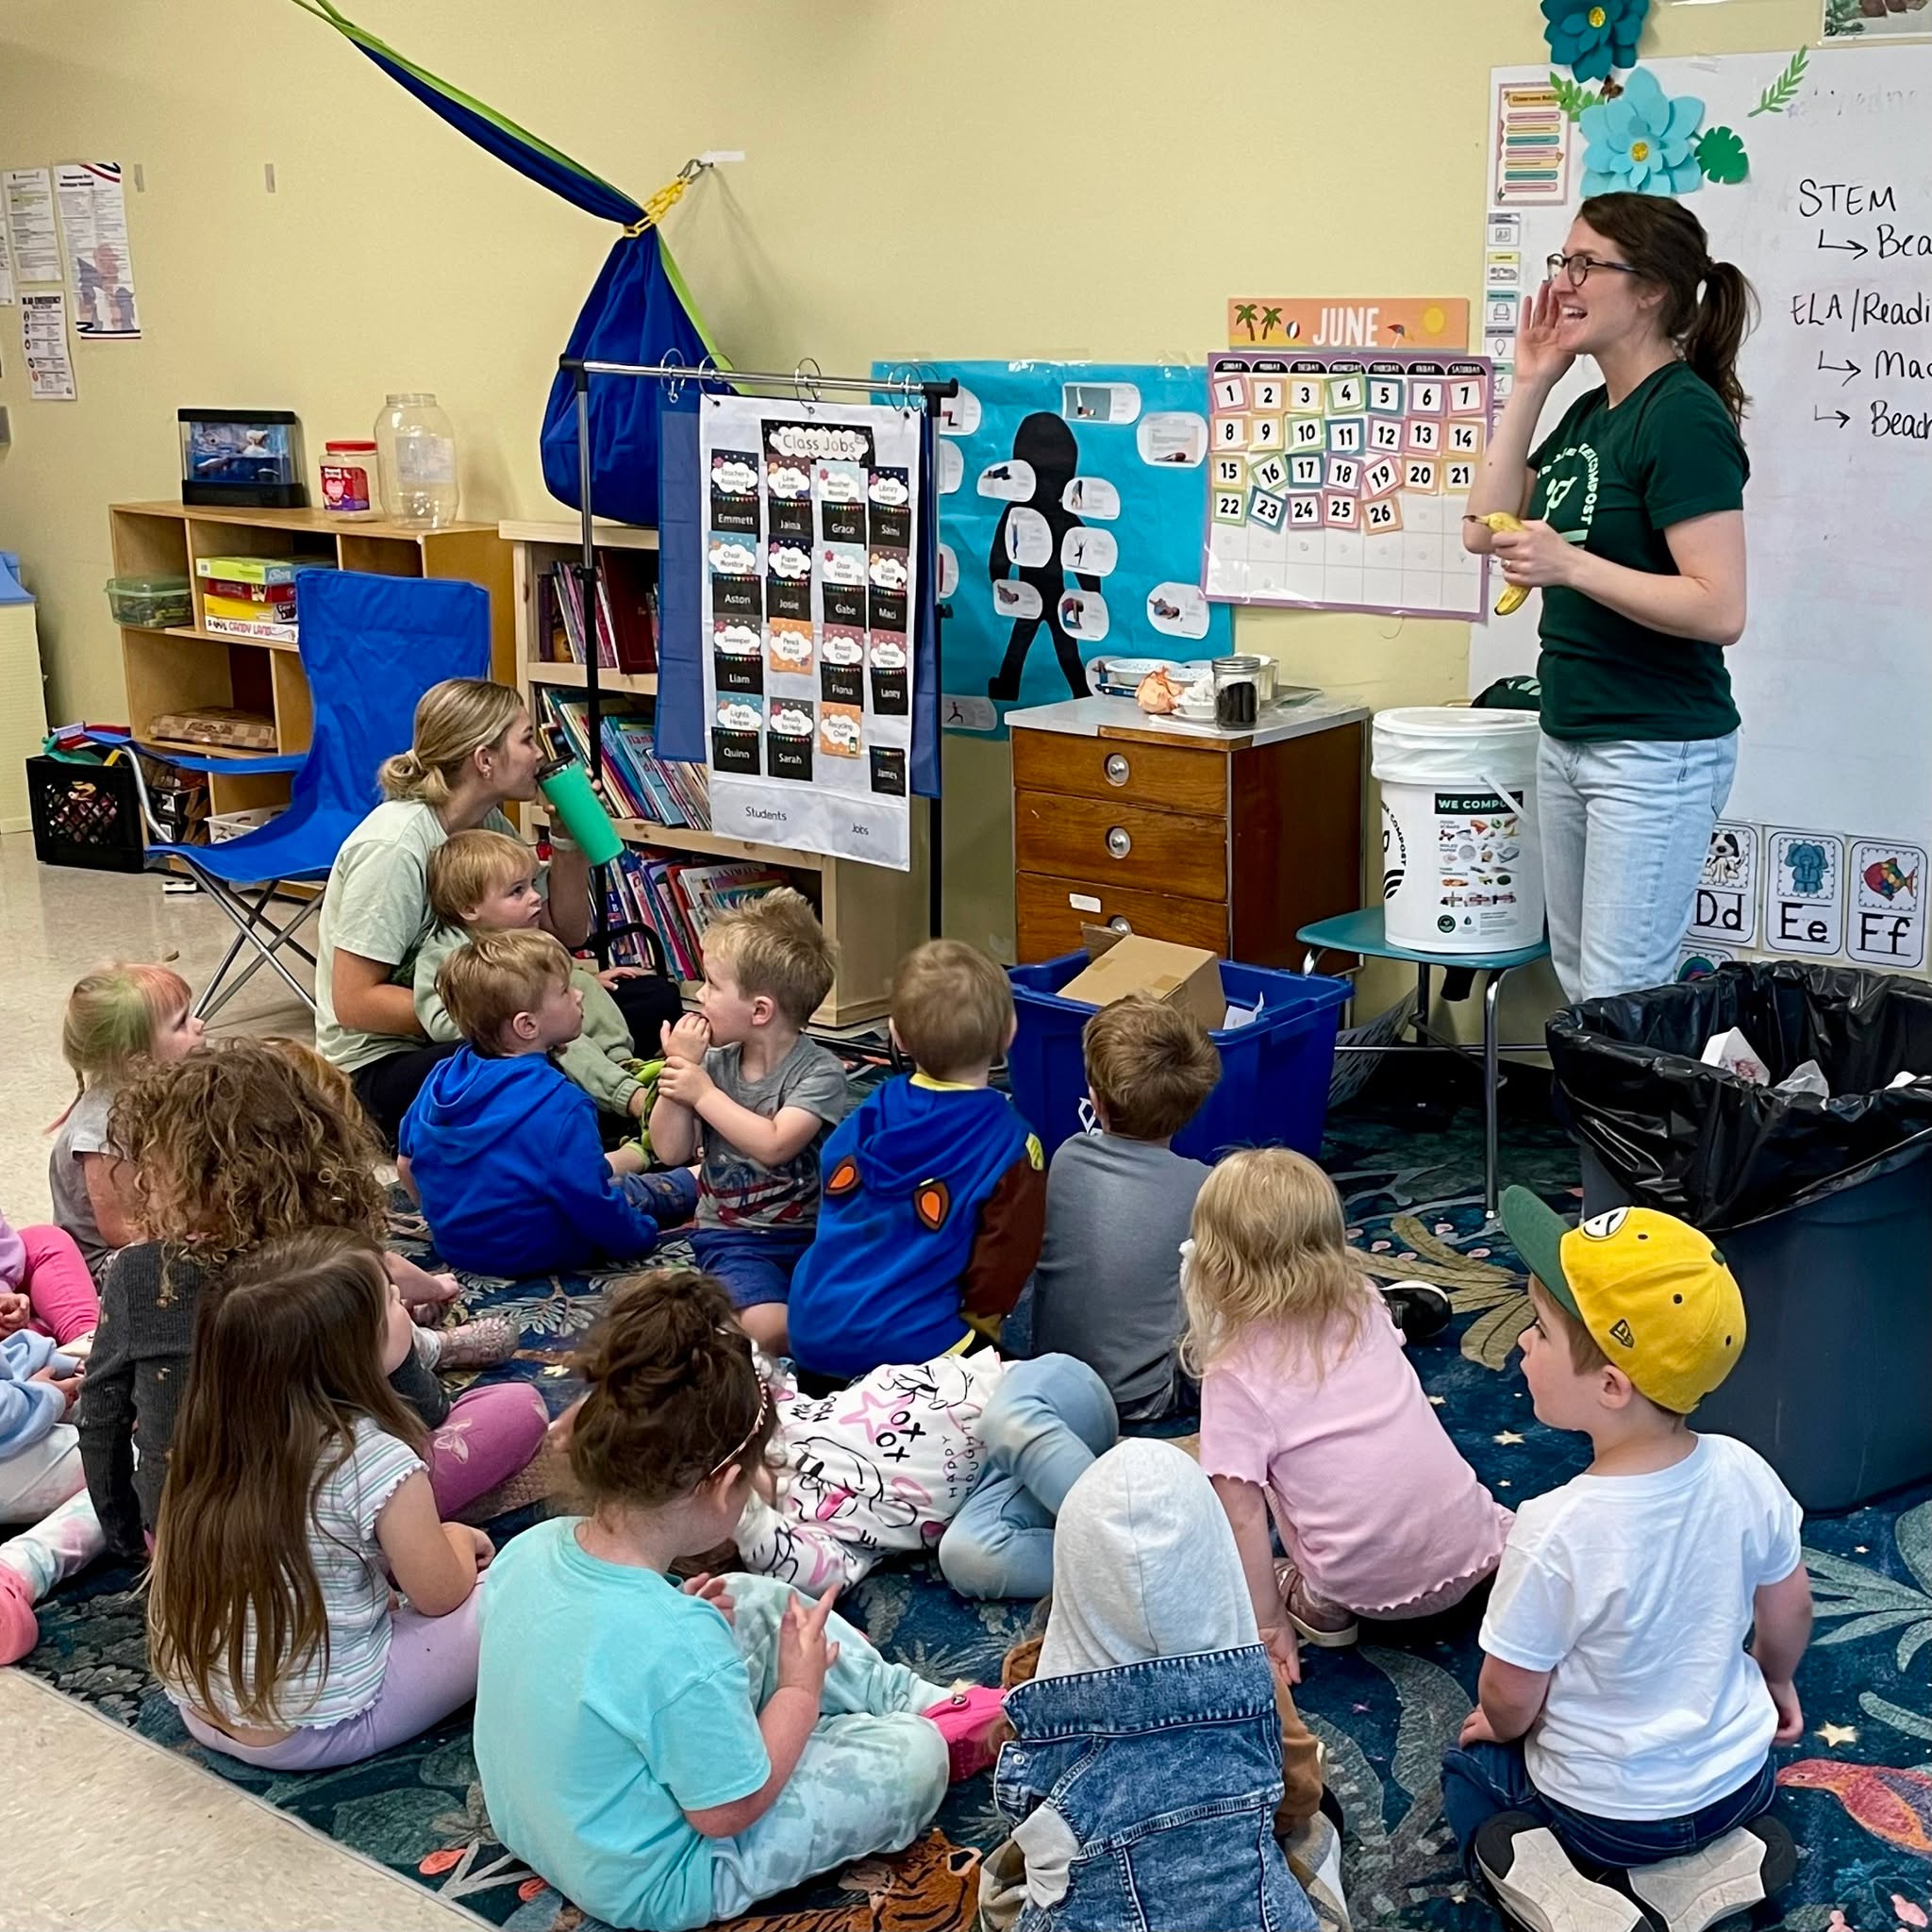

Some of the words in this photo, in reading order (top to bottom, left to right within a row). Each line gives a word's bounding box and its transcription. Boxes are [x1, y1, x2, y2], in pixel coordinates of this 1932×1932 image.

[1799, 178, 1896, 217] STEM
[1312, 307, 1380, 347] JUNE
[1451, 365, 1480, 374] SATURDAY
[1226, 385, 1234, 403] 1
[1263, 387, 1273, 404] 2
[1301, 387, 1309, 403] 3
[1341, 385, 1351, 401] 4
[1380, 387, 1390, 404] 5
[1422, 388, 1432, 406] 6
[1460, 387, 1469, 405] 7
[1225, 423, 1234, 441] 8
[1261, 424, 1271, 441] 9
[1298, 424, 1315, 442] 10
[1339, 428, 1353, 446] 11
[1378, 425, 1395, 445] 12
[1415, 425, 1432, 443] 13
[1455, 429, 1472, 447] 14
[783, 434, 819, 451] Class
[824, 437, 856, 453] Jobs
[1220, 461, 1237, 479] 15
[1261, 463, 1279, 484] 16
[1298, 461, 1314, 478] 17
[1336, 464, 1352, 484] 18
[1372, 465, 1390, 488] 19
[1409, 466, 1431, 484] 20
[1451, 466, 1469, 484] 21
[1220, 498, 1239, 515] 22
[1257, 499, 1278, 519] 23
[1294, 502, 1313, 518] 24
[1331, 501, 1350, 518] 25
[1370, 505, 1391, 523] 26
[718, 513, 754, 525] Emmett
[780, 520, 801, 530] Jaina
[831, 524, 856, 535] Grace
[881, 524, 900, 537] Sami
[724, 593, 751, 605] Aston
[779, 599, 800, 610] Josie
[835, 604, 857, 616] Gabe
[878, 608, 897, 620] Maci
[228, 621, 252, 634] CANDY
[253, 624, 272, 636] LAND
[728, 674, 751, 685] Liam
[831, 684, 854, 696] Fiona
[880, 688, 901, 699] Laney
[730, 709, 750, 719] Lights
[729, 718, 750, 727] Helper
[724, 747, 751, 759] Quinn
[778, 753, 803, 765] Sarah
[877, 768, 898, 780] James
[1438, 799, 1458, 809] WE
[745, 806, 788, 821] Students
[852, 823, 870, 836] Jobs
[1390, 813, 1407, 867] COMPOST
[1697, 890, 1743, 931] Dd
[1780, 901, 1828, 942] Ee
[1861, 912, 1911, 955] Ff
